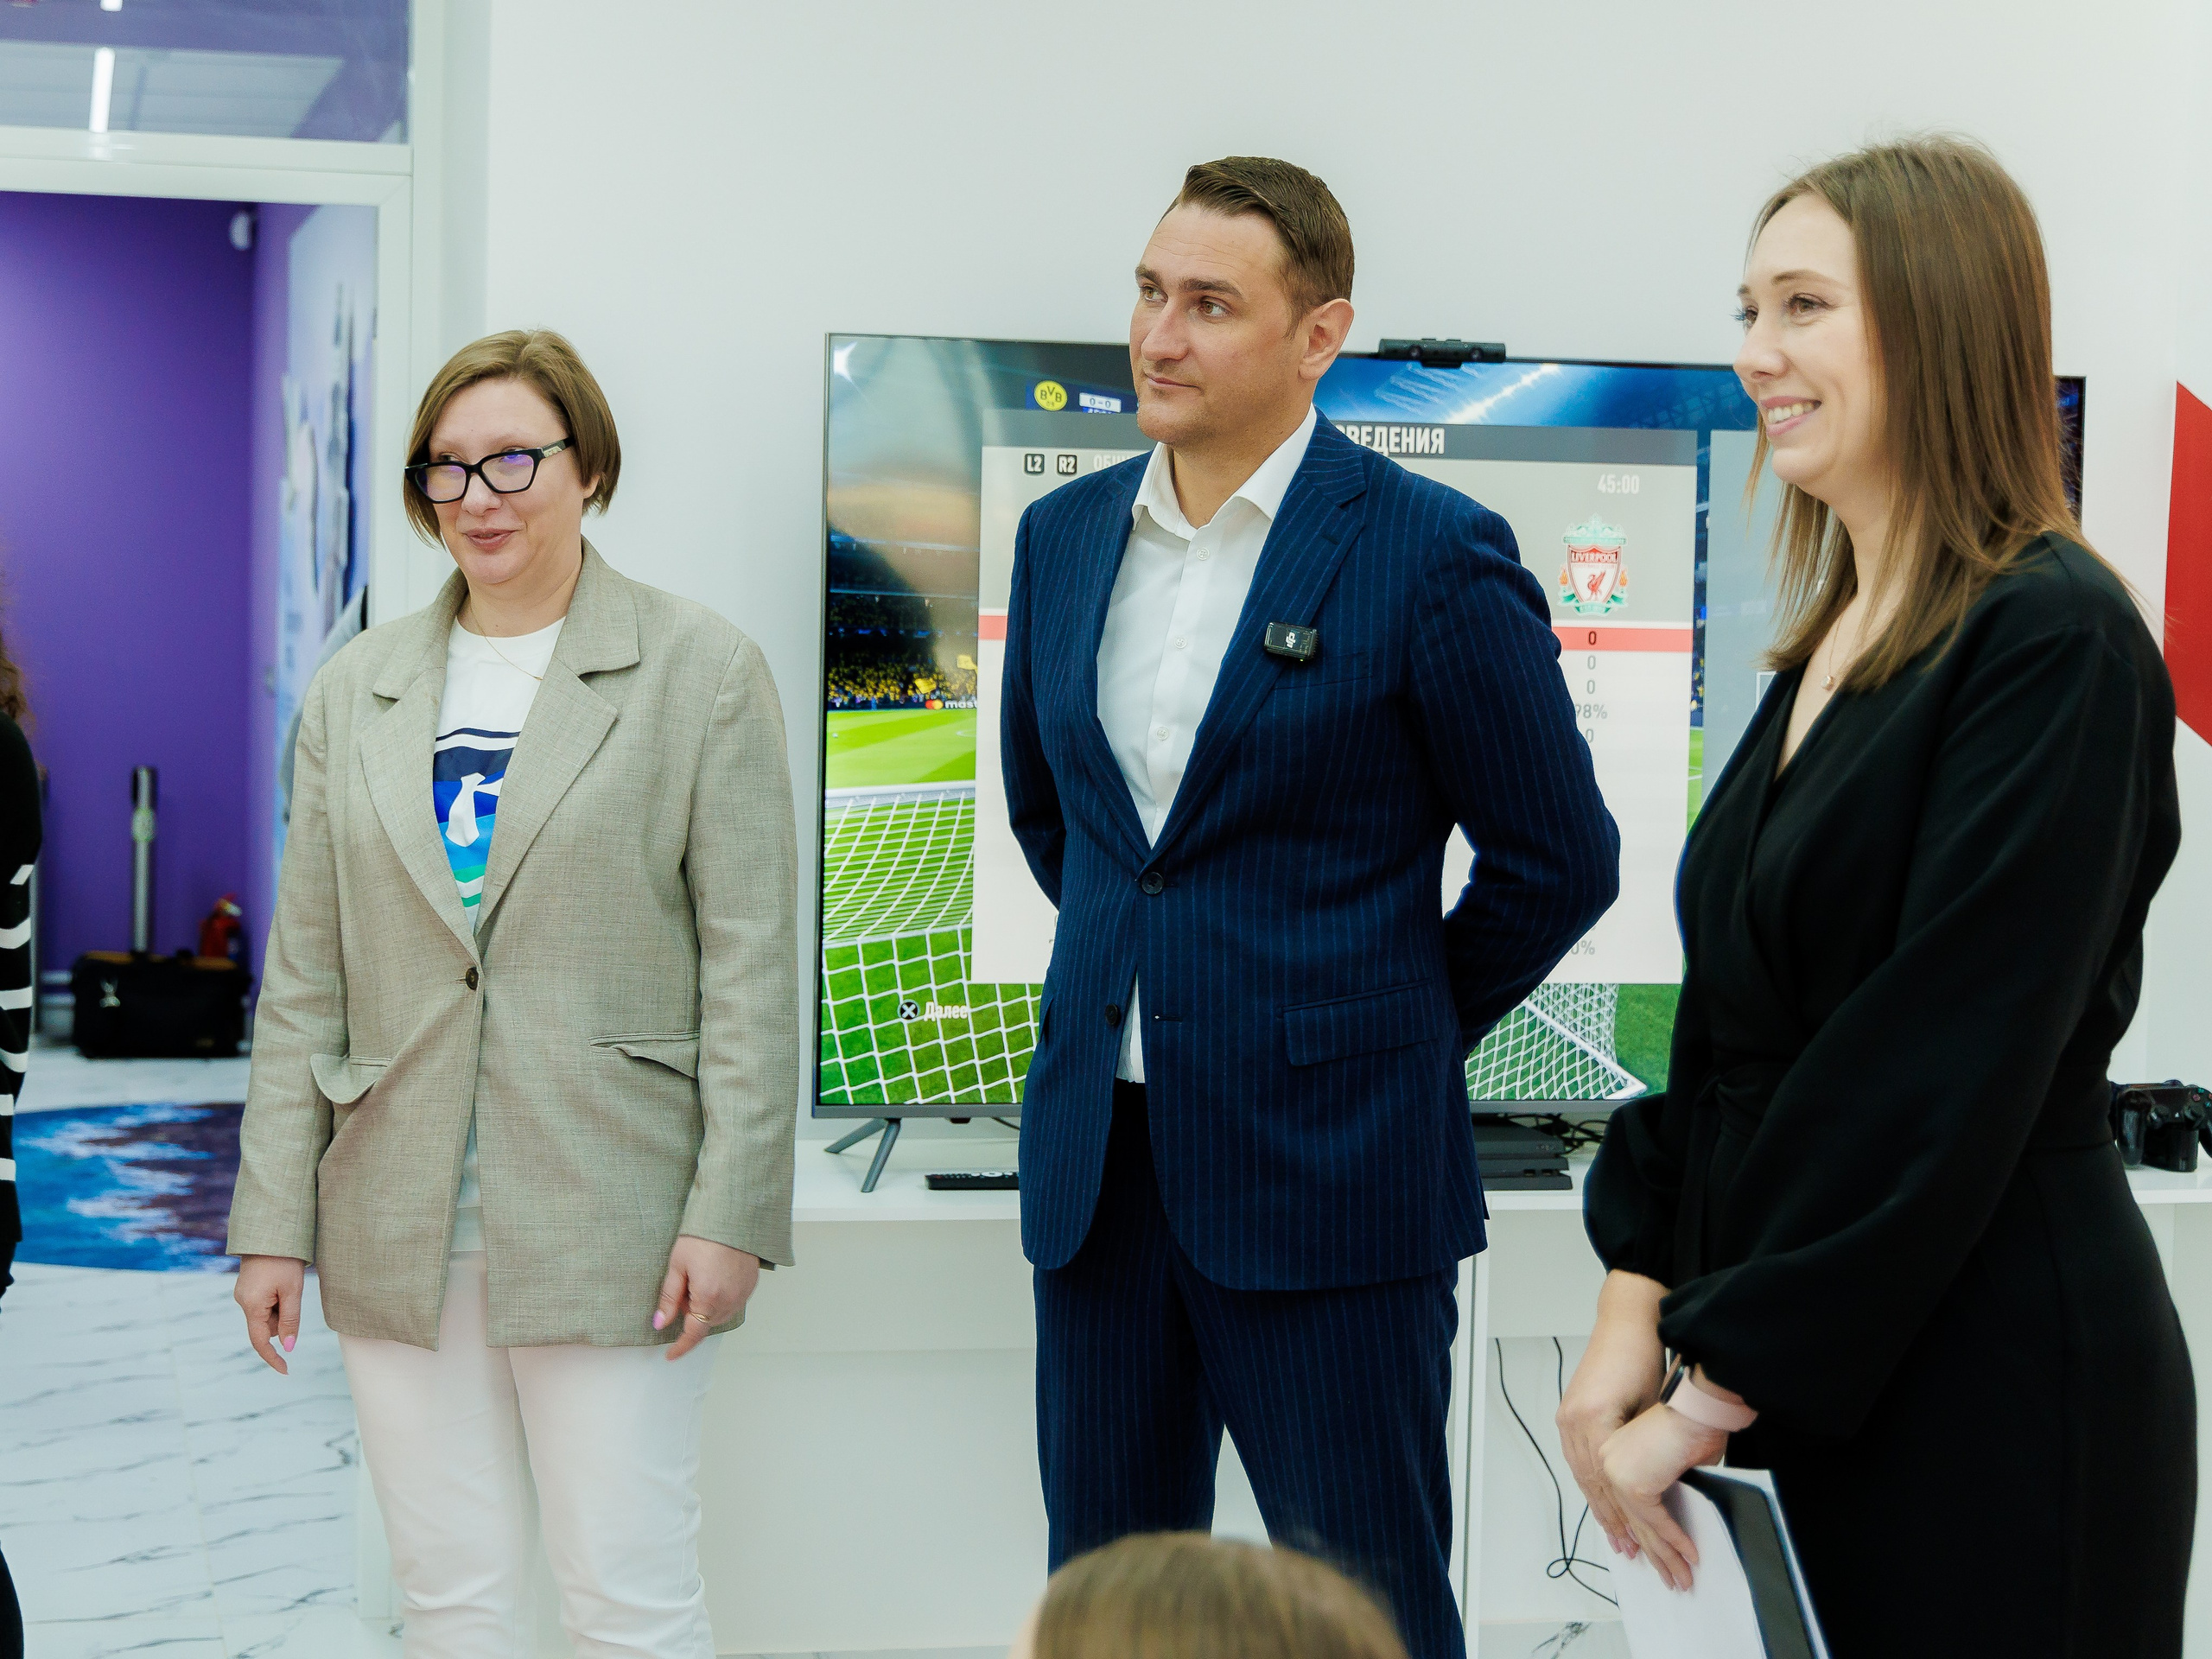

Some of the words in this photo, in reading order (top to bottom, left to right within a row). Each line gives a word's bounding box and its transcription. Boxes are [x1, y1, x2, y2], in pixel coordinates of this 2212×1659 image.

[1040, 386, 1063, 403] BVB
[1026, 454, 1042, 473] L2
[1058, 456, 1075, 473] R2
[1598, 474, 1640, 494] 45:00
[1588, 631, 1597, 645] 0
[1587, 655, 1596, 670] 0
[1586, 680, 1595, 695] 0
[1586, 728, 1594, 743] 0
[923, 1002, 968, 1021] Далее
